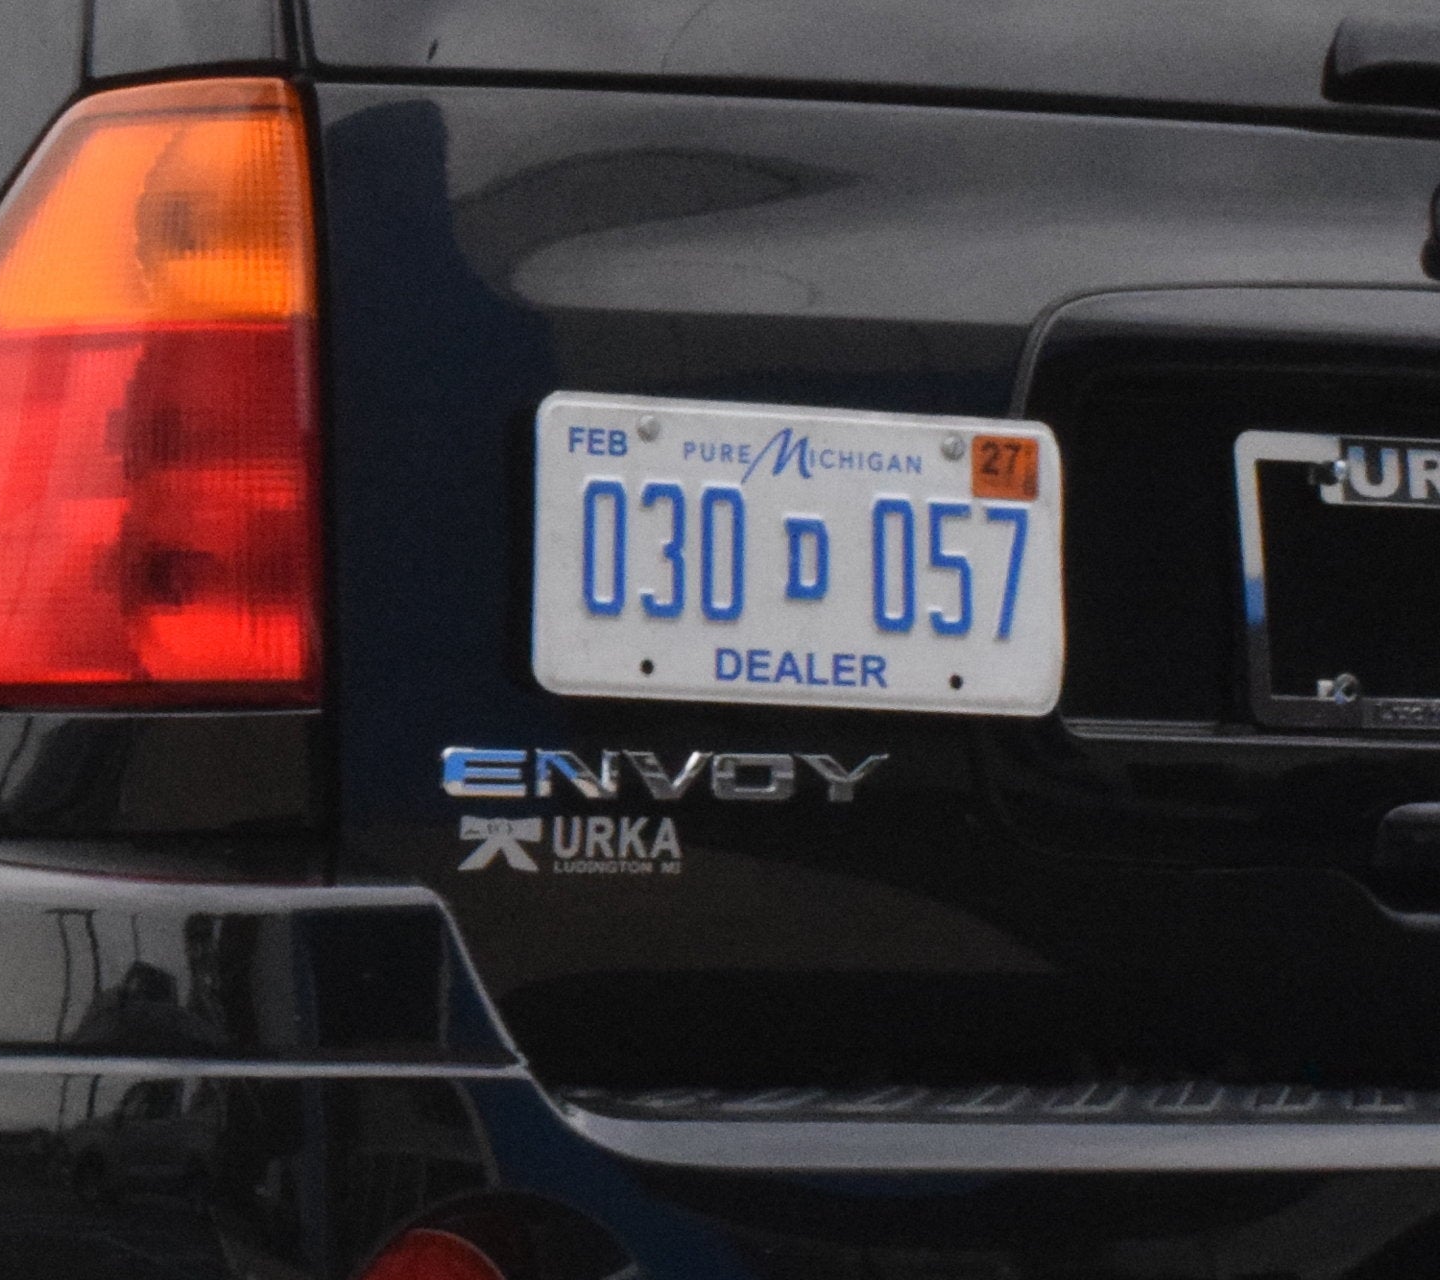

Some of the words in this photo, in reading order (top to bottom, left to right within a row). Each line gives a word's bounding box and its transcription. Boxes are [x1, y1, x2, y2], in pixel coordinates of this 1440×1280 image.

[568, 425, 628, 457] FEB
[682, 439, 752, 465] PURE
[742, 426, 922, 485] MICHIGAN
[980, 441, 1022, 477] 27
[582, 478, 745, 621] 030
[784, 517, 829, 600] D
[872, 497, 1029, 641] 057
[715, 648, 888, 689] DEALER
[442, 746, 890, 802] ENVOY
[552, 816, 683, 859] URKA
[553, 860, 653, 875] LUDINGTON
[661, 861, 681, 875] MI
